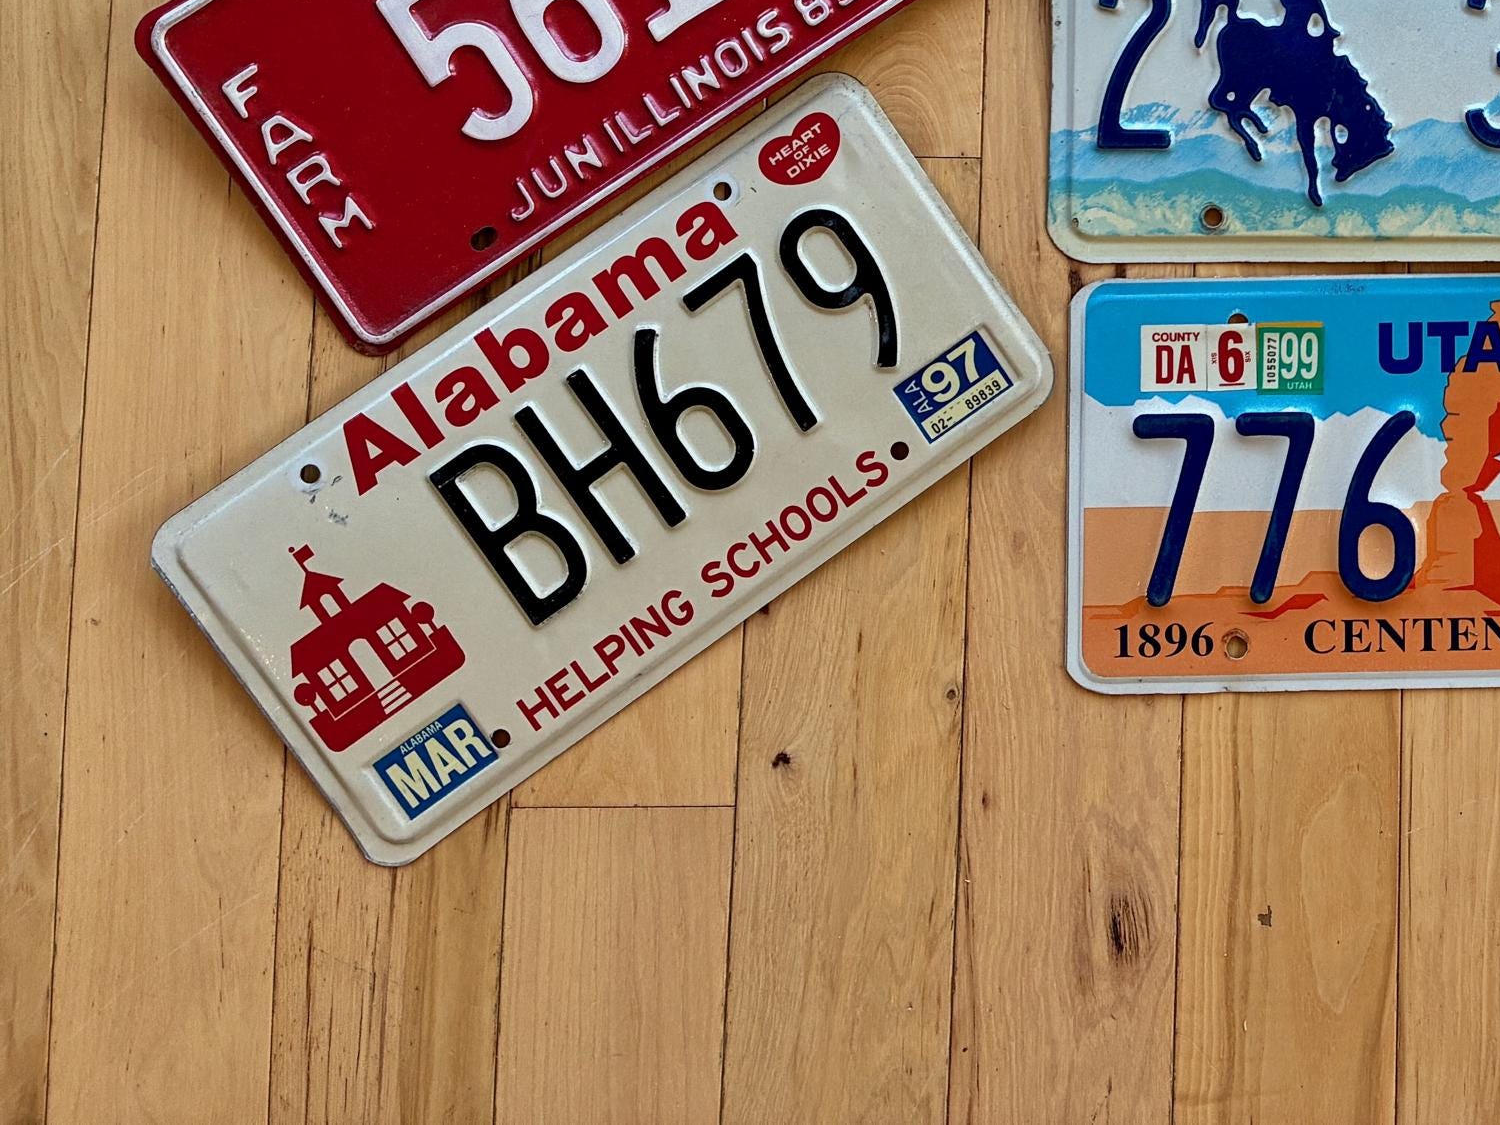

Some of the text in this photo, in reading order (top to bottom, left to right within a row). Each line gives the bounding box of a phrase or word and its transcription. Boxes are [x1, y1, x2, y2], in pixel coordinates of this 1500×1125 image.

[509, 135, 605, 222] JUN
[604, 8, 792, 155] ILLINOIS
[221, 63, 376, 250] FARM
[768, 122, 821, 165] HEART
[786, 143, 831, 179] DIXIE
[793, 145, 810, 160] OF
[337, 200, 741, 497] Alabama
[1152, 331, 1200, 342] COUNTY
[1218, 330, 1245, 383] 6
[1280, 331, 1318, 380] 99
[921, 338, 980, 403] 97
[1155, 345, 1196, 384] DA
[1266, 337, 1277, 383] 1055077
[905, 380, 933, 413] ALA
[964, 380, 1001, 410] 89839
[1286, 382, 1313, 390] UTAH
[427, 209, 900, 627] BH679
[1132, 411, 1417, 607] 776
[515, 449, 890, 730] HELPING SCHOOLS
[1113, 621, 1214, 659] 1896
[400, 721, 443, 755] ALABAMA
[385, 719, 493, 809] MAR
